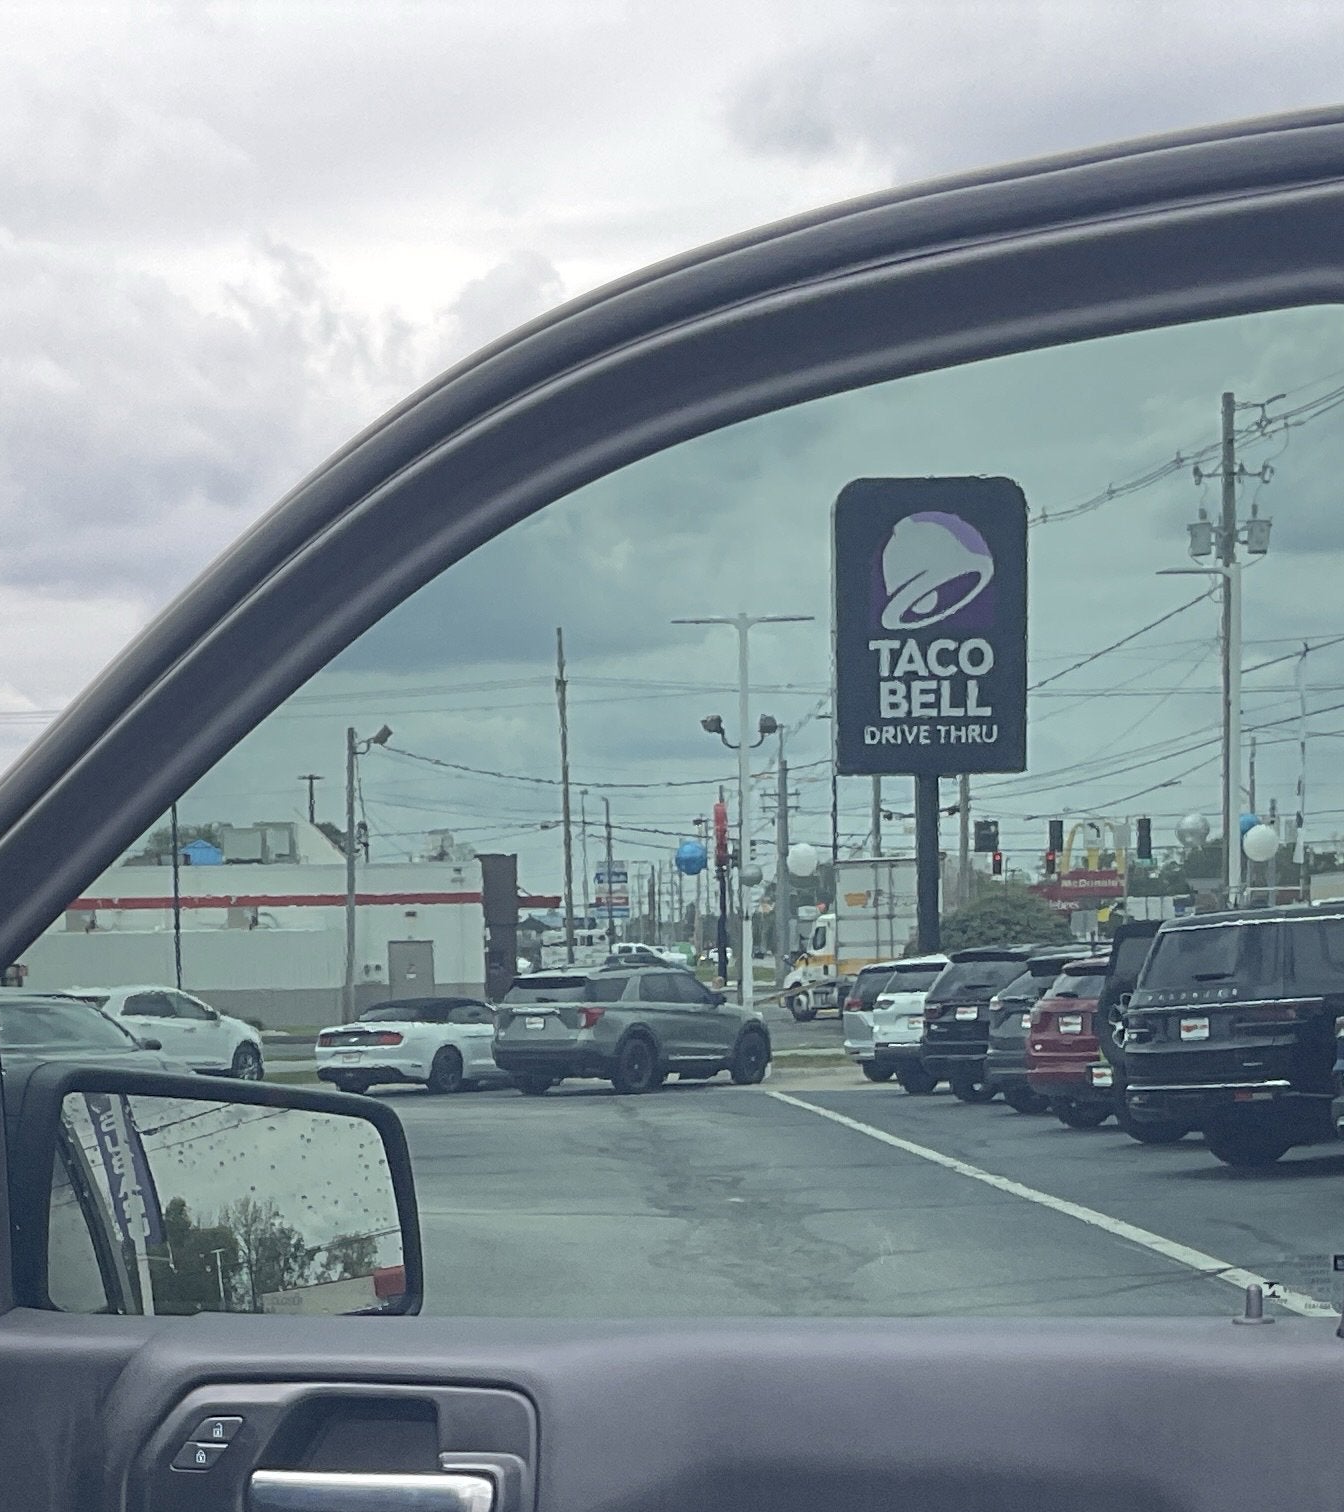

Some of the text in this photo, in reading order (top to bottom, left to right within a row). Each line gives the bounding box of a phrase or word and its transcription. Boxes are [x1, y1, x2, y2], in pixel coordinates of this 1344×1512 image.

[868, 638, 995, 677] TACO
[879, 679, 993, 719] BELL
[864, 724, 999, 745] DRIVE THRU
